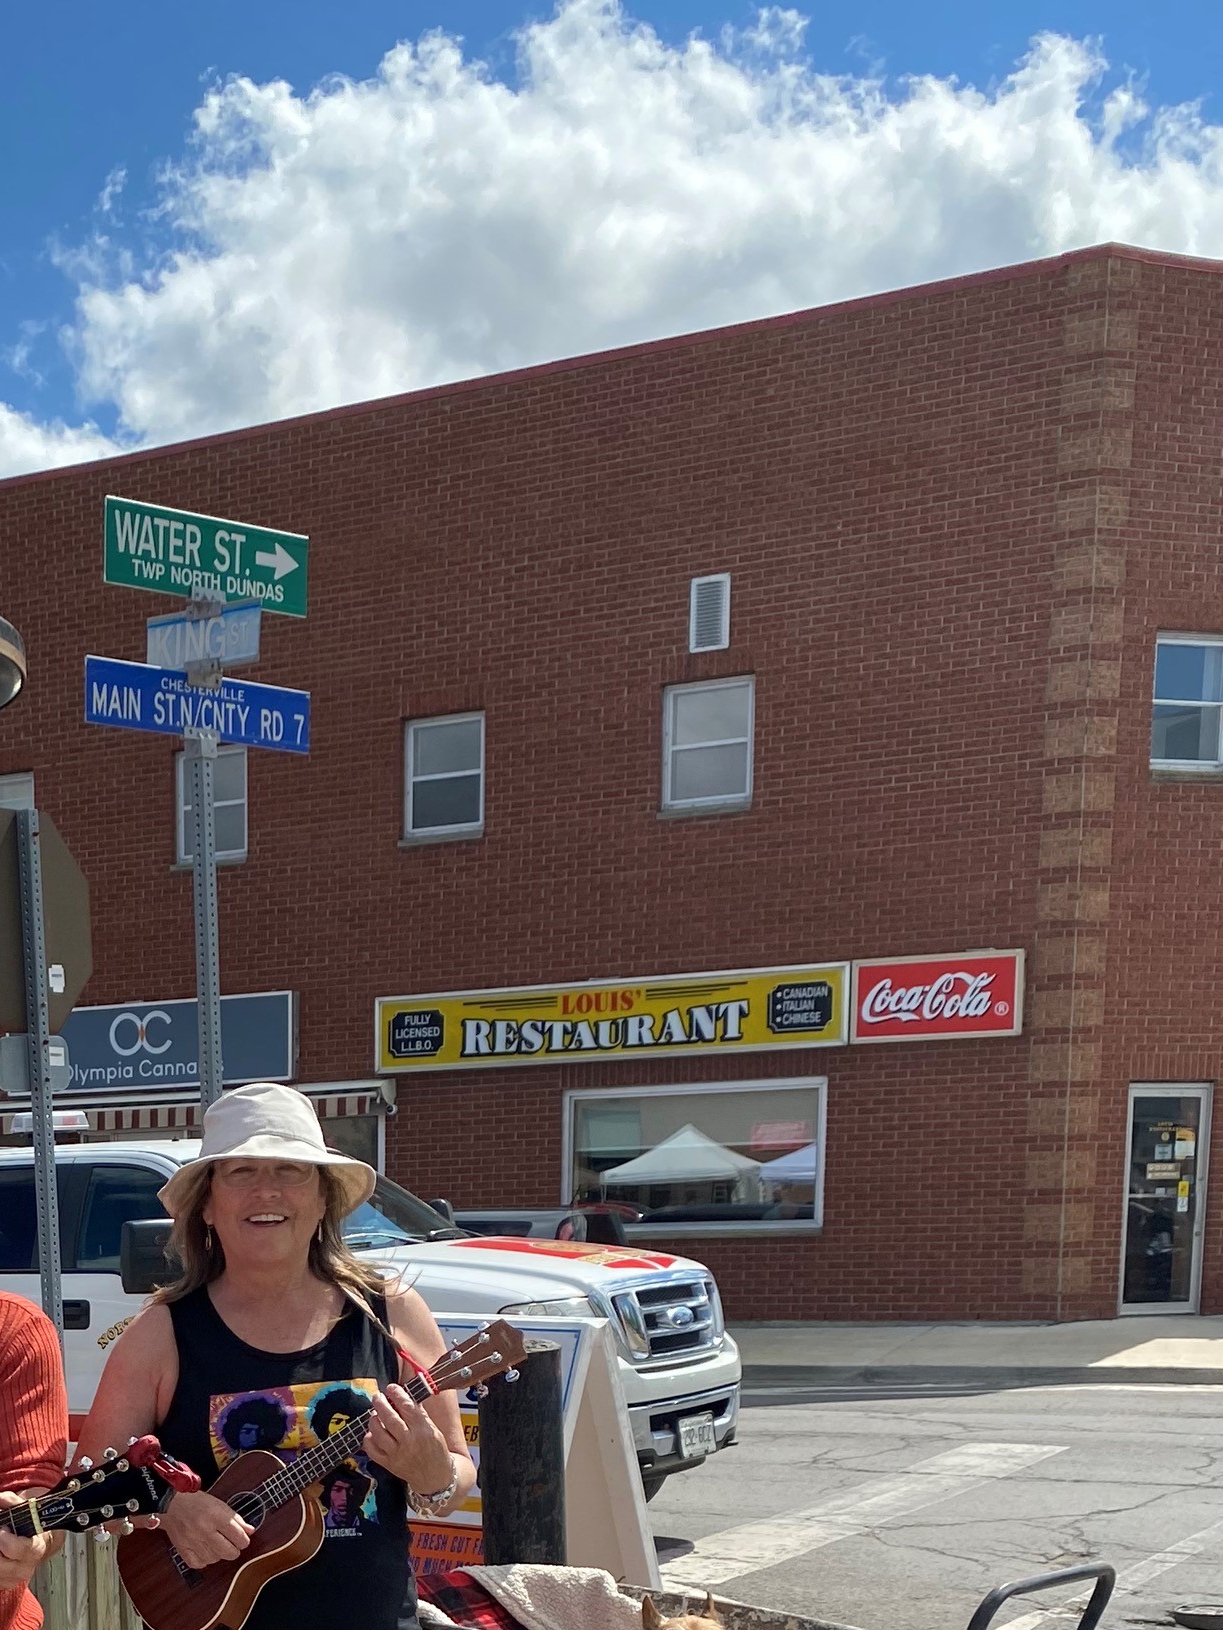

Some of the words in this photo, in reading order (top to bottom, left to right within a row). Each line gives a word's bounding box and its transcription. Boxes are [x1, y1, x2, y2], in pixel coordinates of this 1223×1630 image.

[114, 509, 202, 567] WATER
[214, 530, 251, 575] ST.
[132, 558, 166, 581] TWP
[170, 566, 221, 593] NORTH
[226, 576, 284, 602] DUNDAS
[154, 616, 226, 667] KING
[230, 621, 249, 646] ST
[92, 682, 142, 721] MAIN
[260, 710, 284, 742] RD
[293, 713, 305, 745] 7
[561, 988, 642, 1016] LOUIS'
[782, 985, 829, 999] CANADIAN
[782, 999, 815, 1012] ITALIAN
[861, 971, 997, 1024] Coca-Cola
[395, 1026, 440, 1040] LICENSED
[404, 1014, 431, 1026] FULLY
[462, 999, 749, 1056] RESTAURANT
[782, 1011, 822, 1024] CHINESE
[140, 1466, 159, 1501] piphone
[417, 1532, 449, 1553] FRESH
[450, 1536, 472, 1555] CUT
